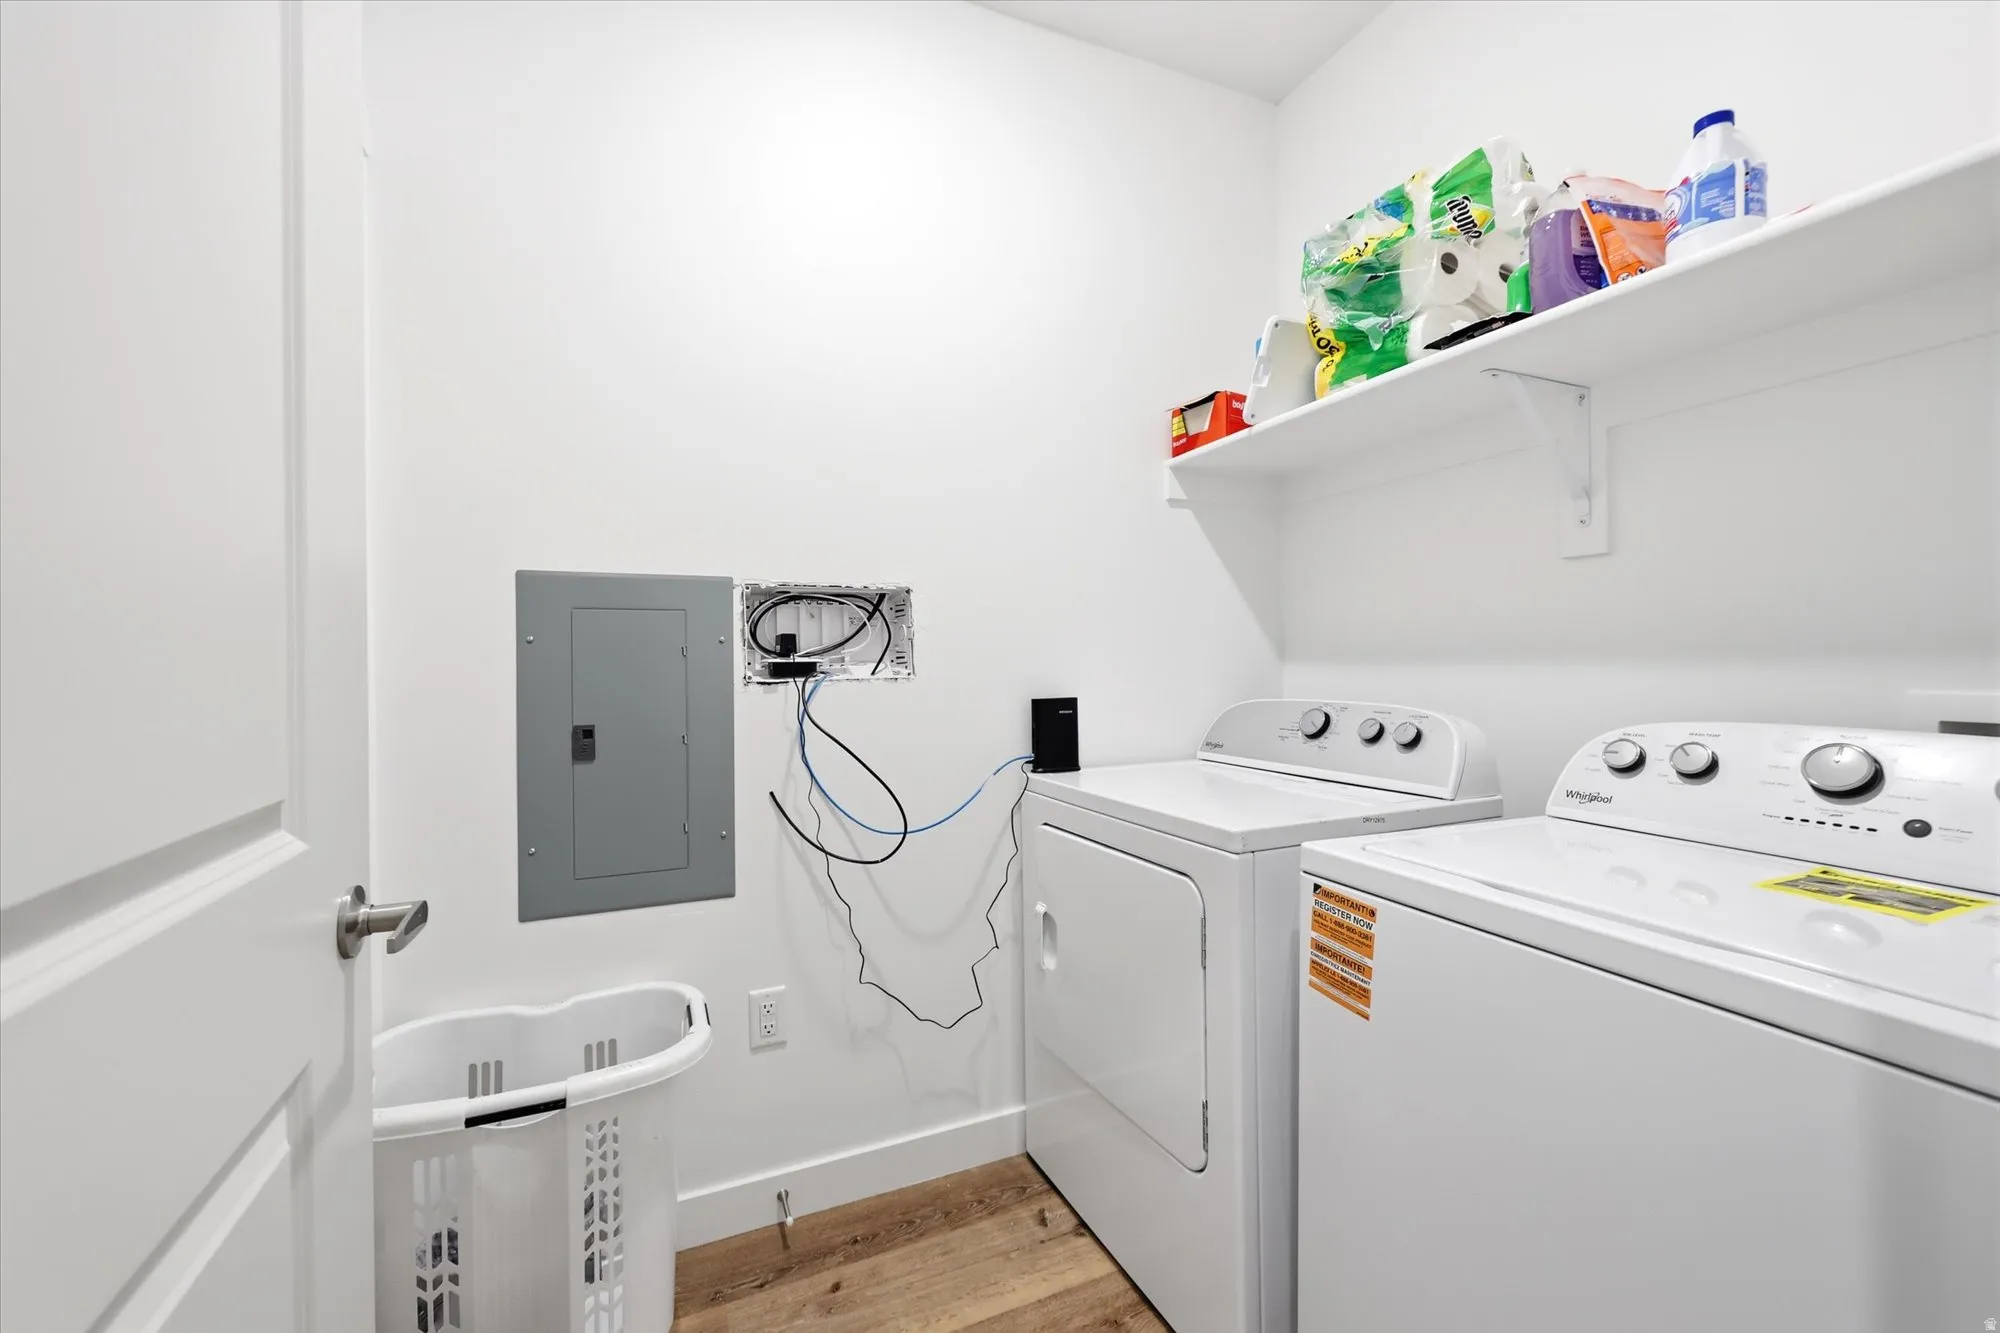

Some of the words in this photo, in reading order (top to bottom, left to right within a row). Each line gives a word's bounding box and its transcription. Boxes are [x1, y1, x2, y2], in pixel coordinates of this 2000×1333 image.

[1566, 789, 1613, 804] Whirlpool
[1321, 888, 1370, 915] IMPORTANT!
[1313, 910, 1329, 922] CALL
[1314, 899, 1352, 921] REGISTER
[1352, 916, 1374, 930] NOW
